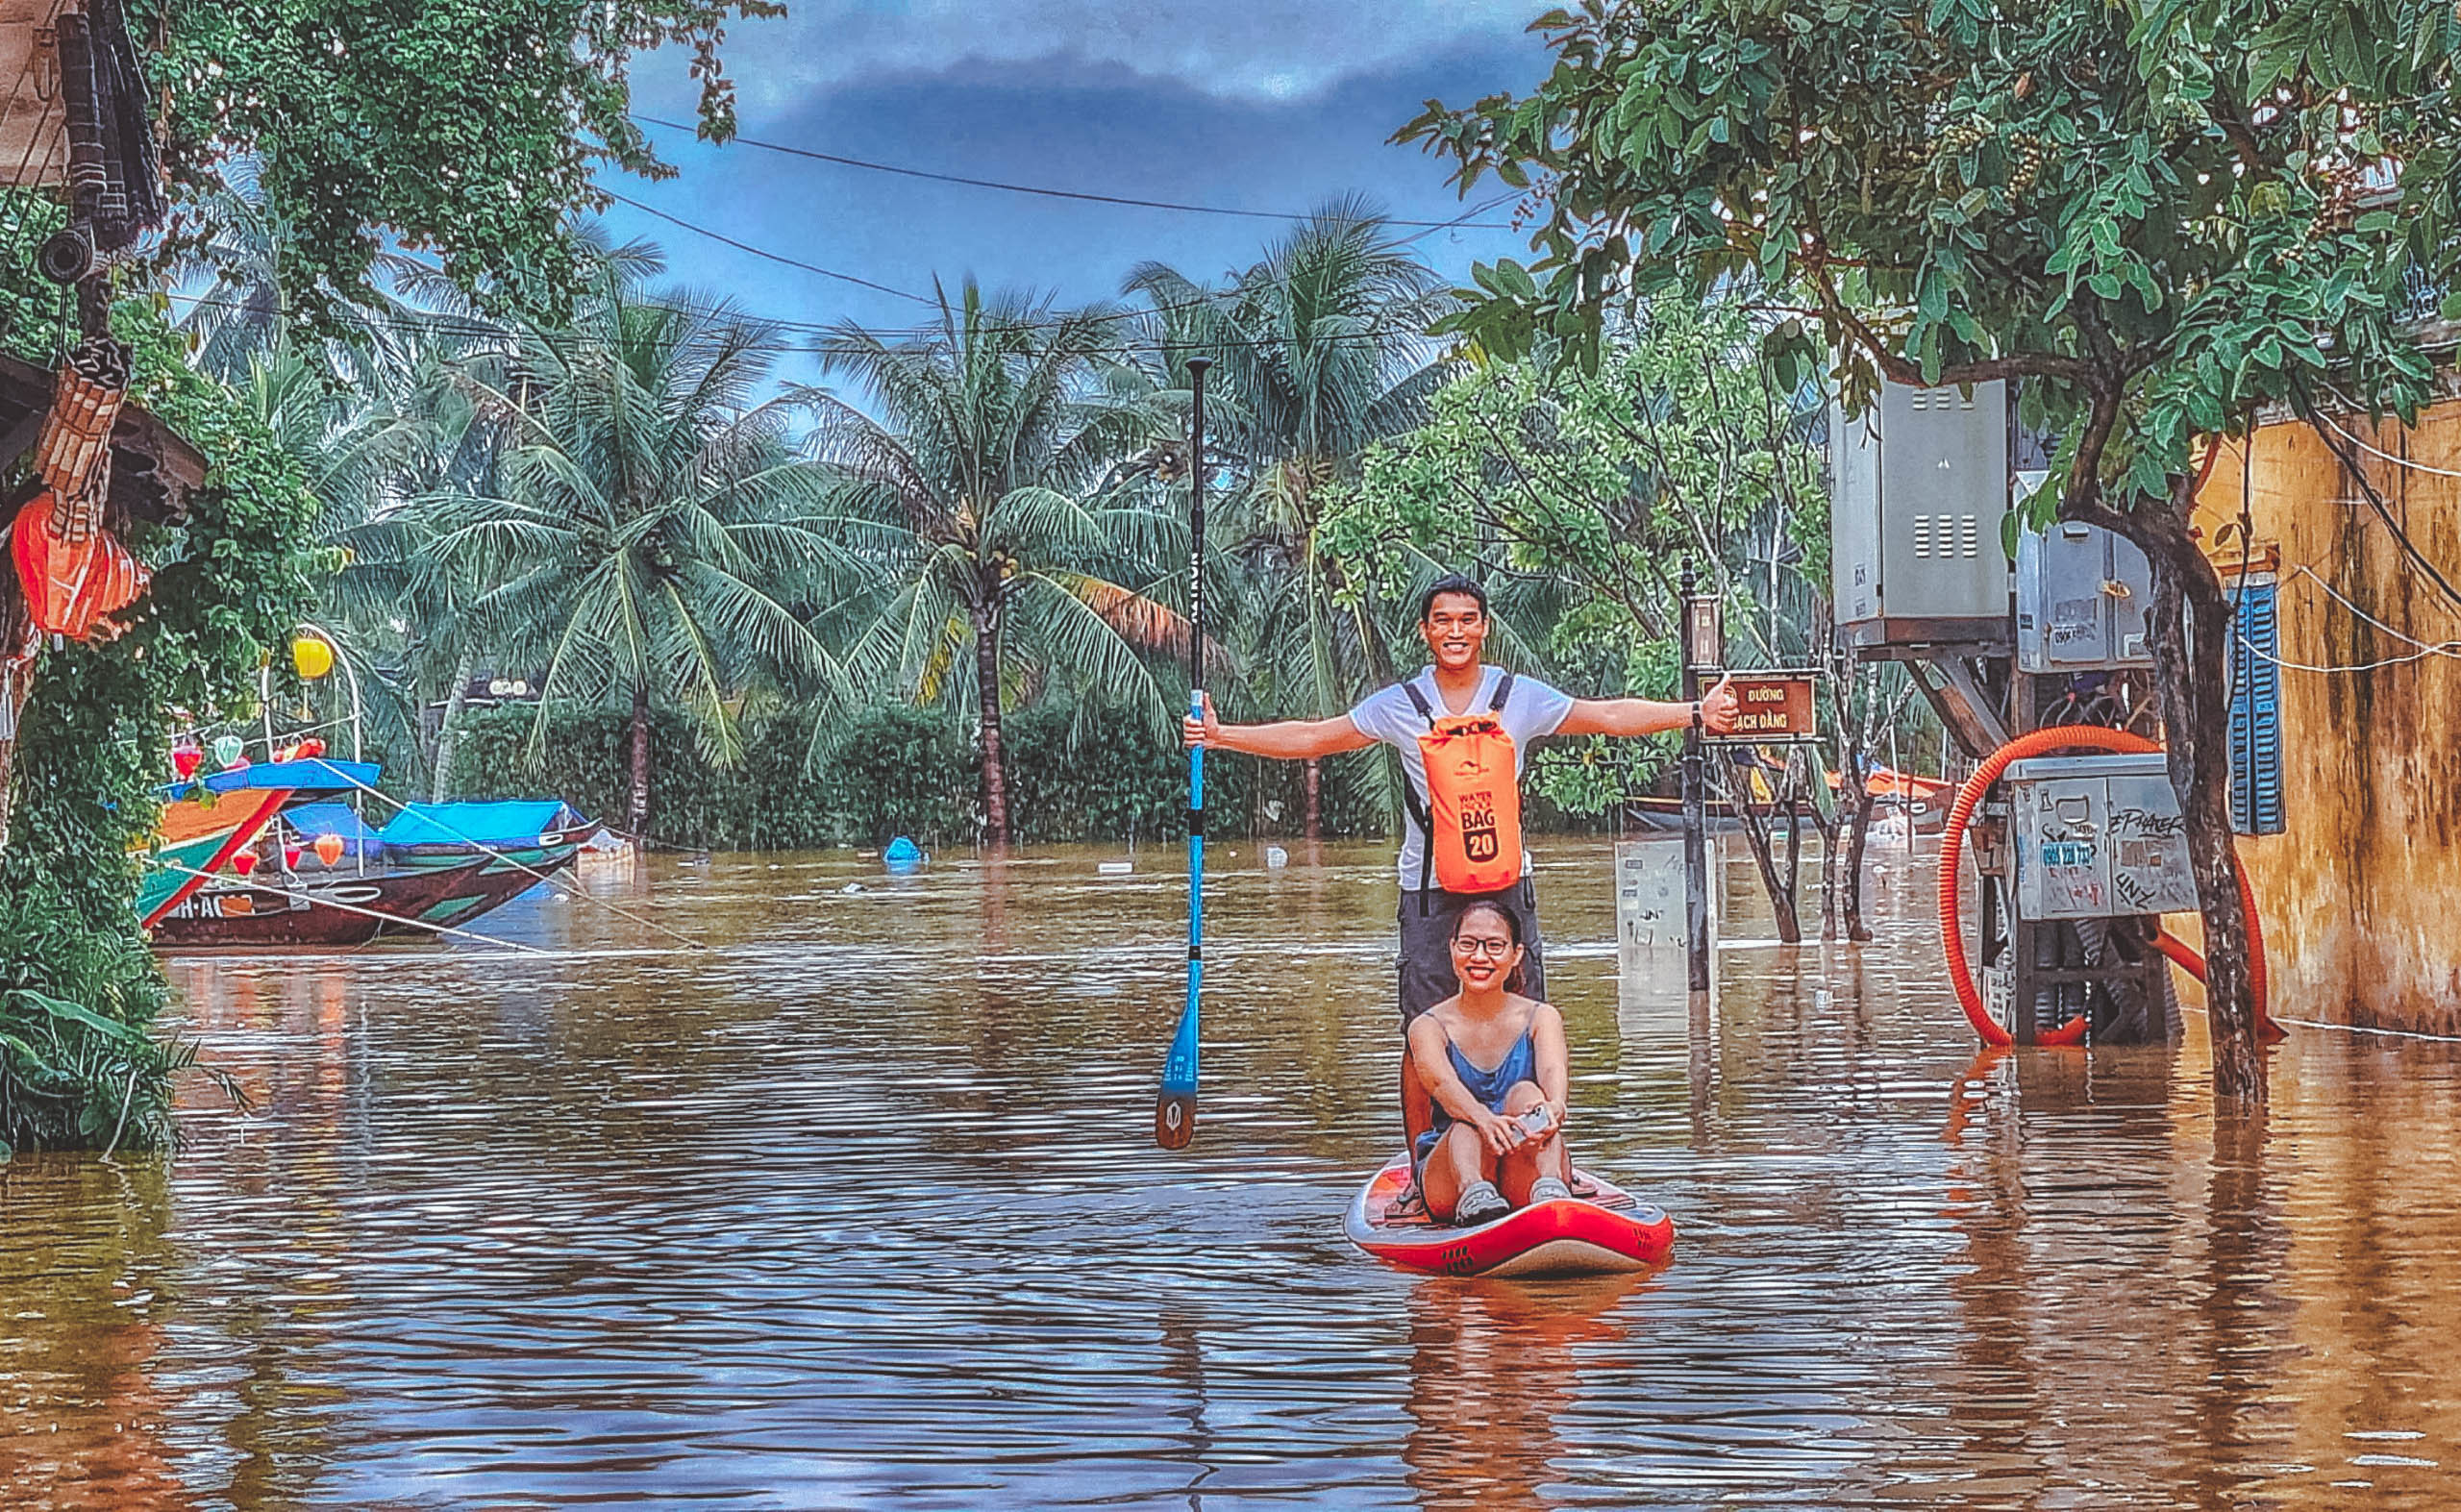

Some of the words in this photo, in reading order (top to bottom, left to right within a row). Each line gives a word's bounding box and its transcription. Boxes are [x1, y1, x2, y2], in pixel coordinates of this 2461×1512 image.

[1748, 685, 1785, 703] ĐƯỜNG
[1461, 808, 1496, 830] BAG
[1469, 833, 1494, 856] 20
